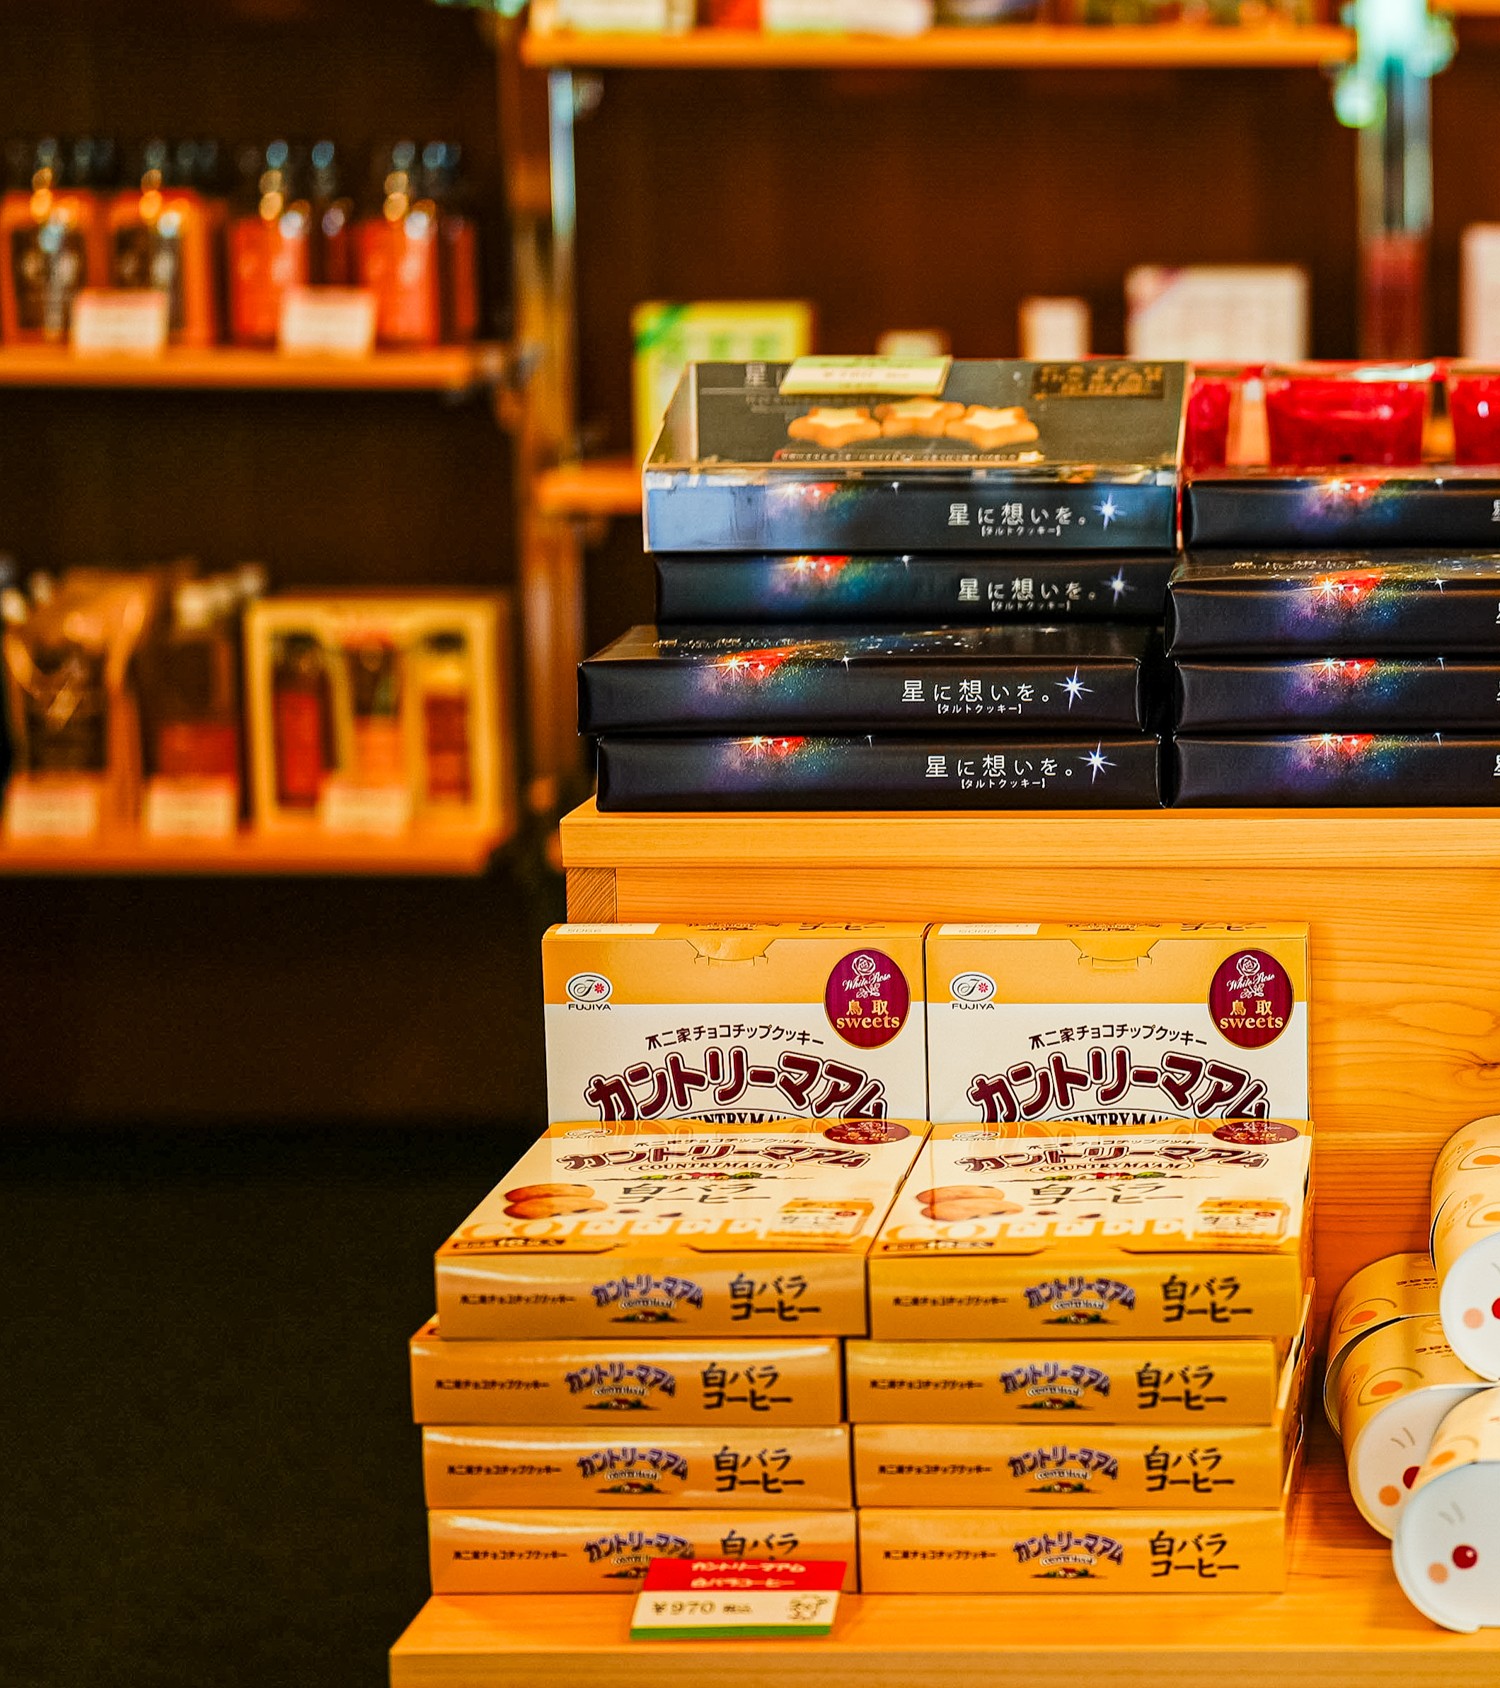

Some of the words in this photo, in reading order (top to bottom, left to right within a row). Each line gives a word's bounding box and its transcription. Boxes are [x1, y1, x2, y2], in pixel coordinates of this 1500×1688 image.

[901, 679, 1052, 704] 星に想いを。
[925, 756, 1075, 779] 星に想いを。
[567, 1003, 612, 1011] FUJIYA
[845, 999, 888, 1016] 鳥取
[951, 1003, 996, 1011] FUJIYA
[1229, 999, 1273, 1016] 鳥取
[836, 1013, 900, 1030] sweets
[1219, 1013, 1284, 1030] sweets
[584, 1046, 889, 1119] カントリーマアム
[967, 1046, 1271, 1120] カントリーマアム
[556, 1144, 872, 1171] カントリーマアム
[954, 1145, 1271, 1173] カントリーマアム
[730, 1272, 808, 1298] 白バラ
[1162, 1273, 1241, 1300] 白バラ
[731, 1302, 822, 1322] コーヒー
[1163, 1303, 1253, 1324] コーヒー
[701, 1361, 780, 1389] 白バラ
[1136, 1361, 1216, 1389] 白バラ
[702, 1391, 793, 1411] コーヒー
[1137, 1391, 1227, 1412] コーヒー
[713, 1445, 793, 1473] 白バラ
[1144, 1444, 1224, 1473] 白バラ
[714, 1474, 805, 1494] コーヒー
[1144, 1474, 1235, 1494] コーヒー
[720, 1529, 799, 1556] 白バラ
[1149, 1529, 1229, 1558] 白バラ
[1151, 1560, 1240, 1579] コーヒー
